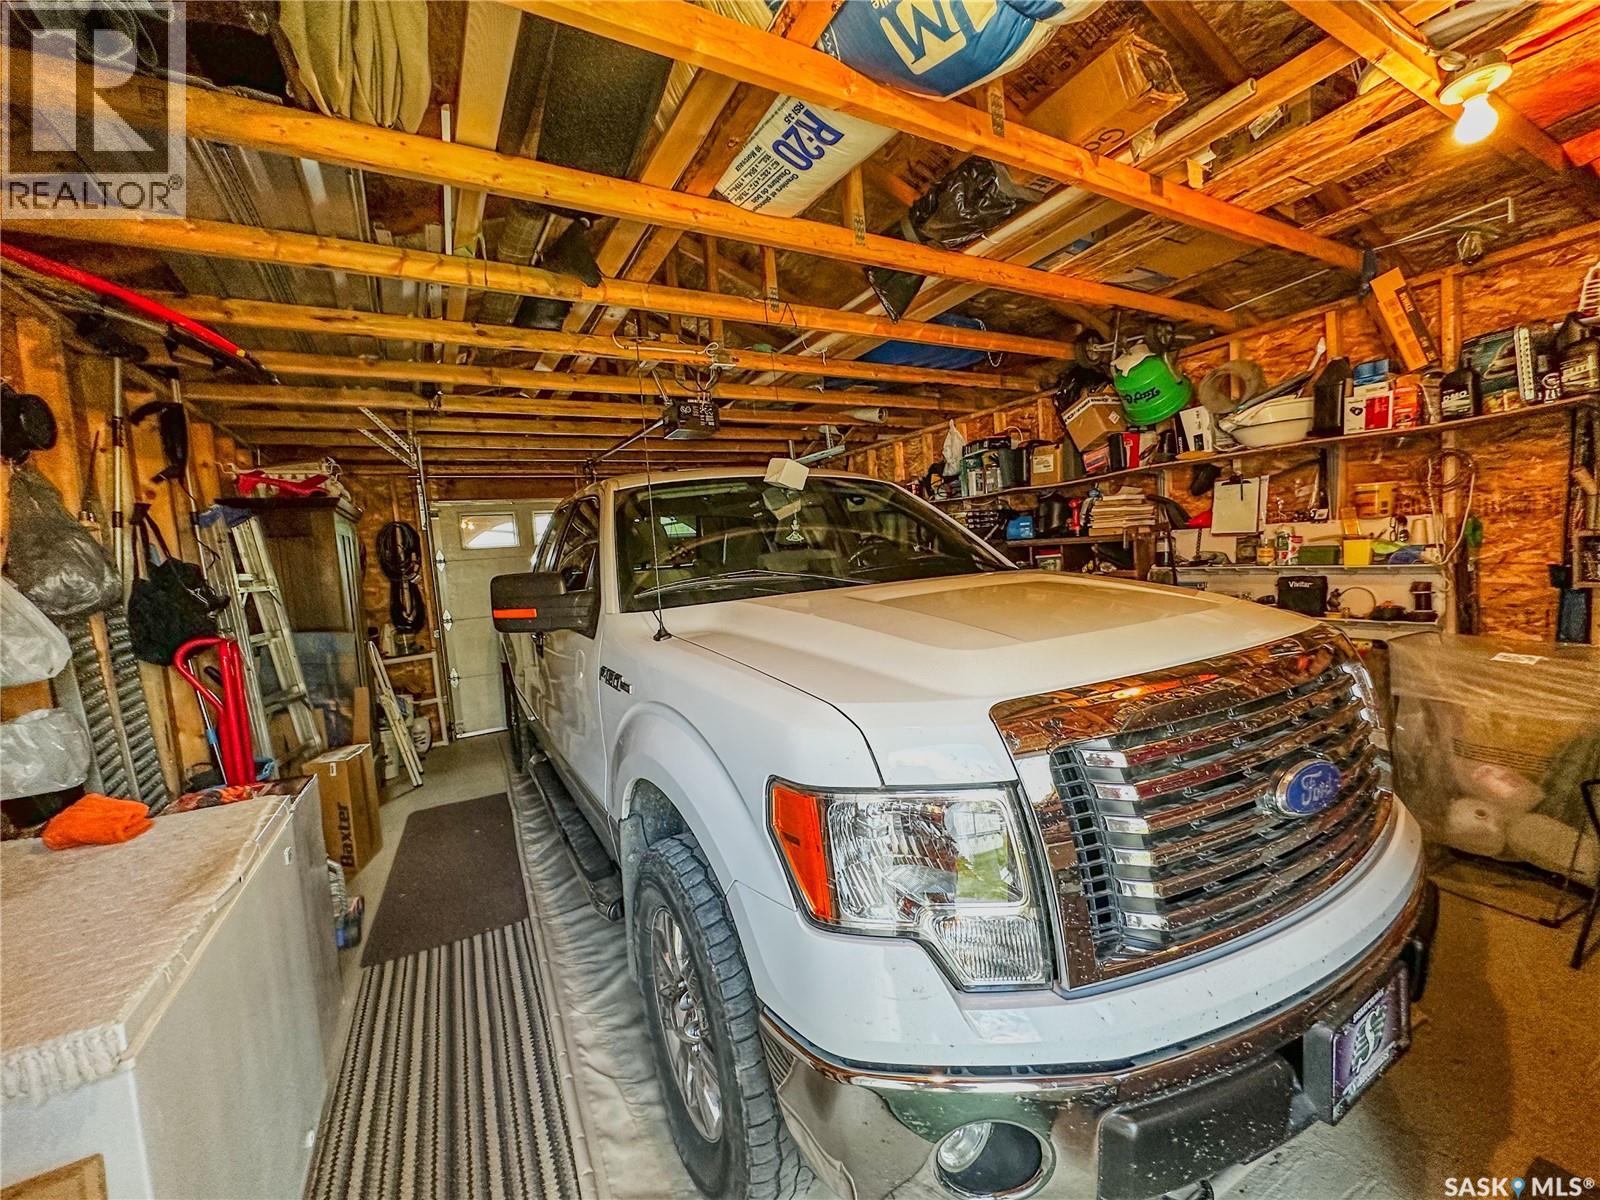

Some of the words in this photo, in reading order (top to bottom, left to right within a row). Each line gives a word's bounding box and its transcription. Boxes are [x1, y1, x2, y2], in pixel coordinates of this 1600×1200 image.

[791, 101, 805, 116] RSI
[1301, 770, 1332, 806] Ford
[338, 802, 356, 867] Baxter
